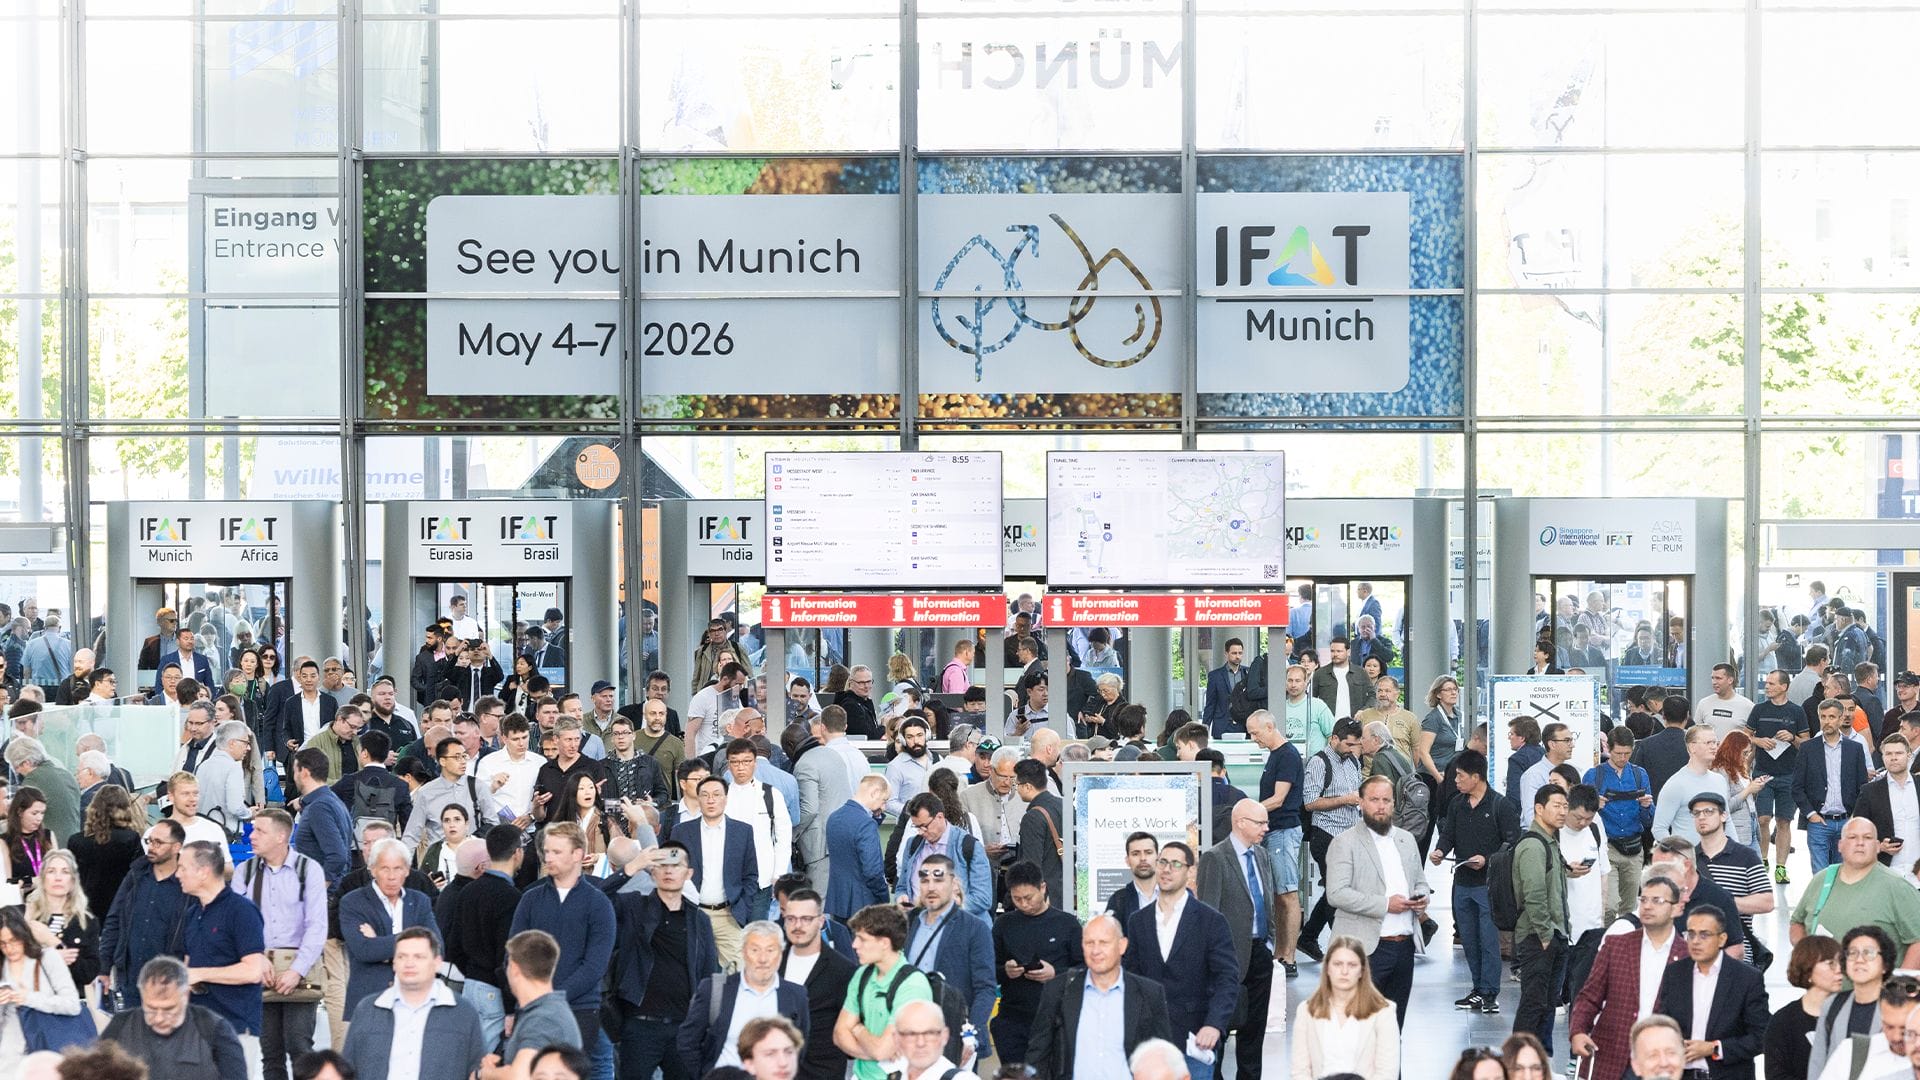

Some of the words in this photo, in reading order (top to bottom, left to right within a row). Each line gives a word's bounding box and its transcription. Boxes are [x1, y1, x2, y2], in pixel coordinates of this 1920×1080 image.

[214, 208, 317, 230] Eingang
[215, 239, 324, 258] Entrance
[457, 239, 535, 275] See
[549, 248, 621, 284] you
[644, 239, 680, 274] in
[698, 239, 861, 274] Munich
[1215, 225, 1370, 287] IFAT
[1246, 309, 1374, 342] Munich
[459, 322, 542, 366] May
[644, 322, 735, 356] 2026
[951, 456, 970, 464] 8:55
[273, 468, 452, 486] Willkmme!
[140, 518, 191, 541] IFAT
[220, 517, 277, 541] IFAT
[421, 516, 472, 540] IFAT
[501, 516, 557, 540] IFAT
[699, 516, 752, 540] IFAT
[1559, 527, 1593, 535] Singapore
[1651, 521, 1682, 532] ASIA
[1340, 523, 1402, 545] IEexpo
[1607, 535, 1633, 545] IFAT
[430, 548, 473, 560] Eurasia
[524, 547, 559, 560] Brasil
[1651, 544, 1683, 552] FORUM
[149, 549, 193, 562] Munich
[241, 549, 278, 562] Africa
[722, 548, 753, 561] India
[790, 597, 857, 609] Information
[913, 597, 980, 609] Information
[1072, 597, 1139, 609] Information
[1194, 597, 1262, 608] Information
[790, 611, 857, 623] Information
[913, 611, 981, 623] Information
[1072, 611, 1139, 622] Information
[1194, 611, 1262, 622] Information
[1499, 700, 1522, 709] IFAT
[1566, 700, 1588, 709] IFAT
[1110, 794, 1163, 803] smartboxx
[1095, 818, 1128, 829] Meet
[1131, 818, 1141, 829] &
[1145, 818, 1178, 829] Work
